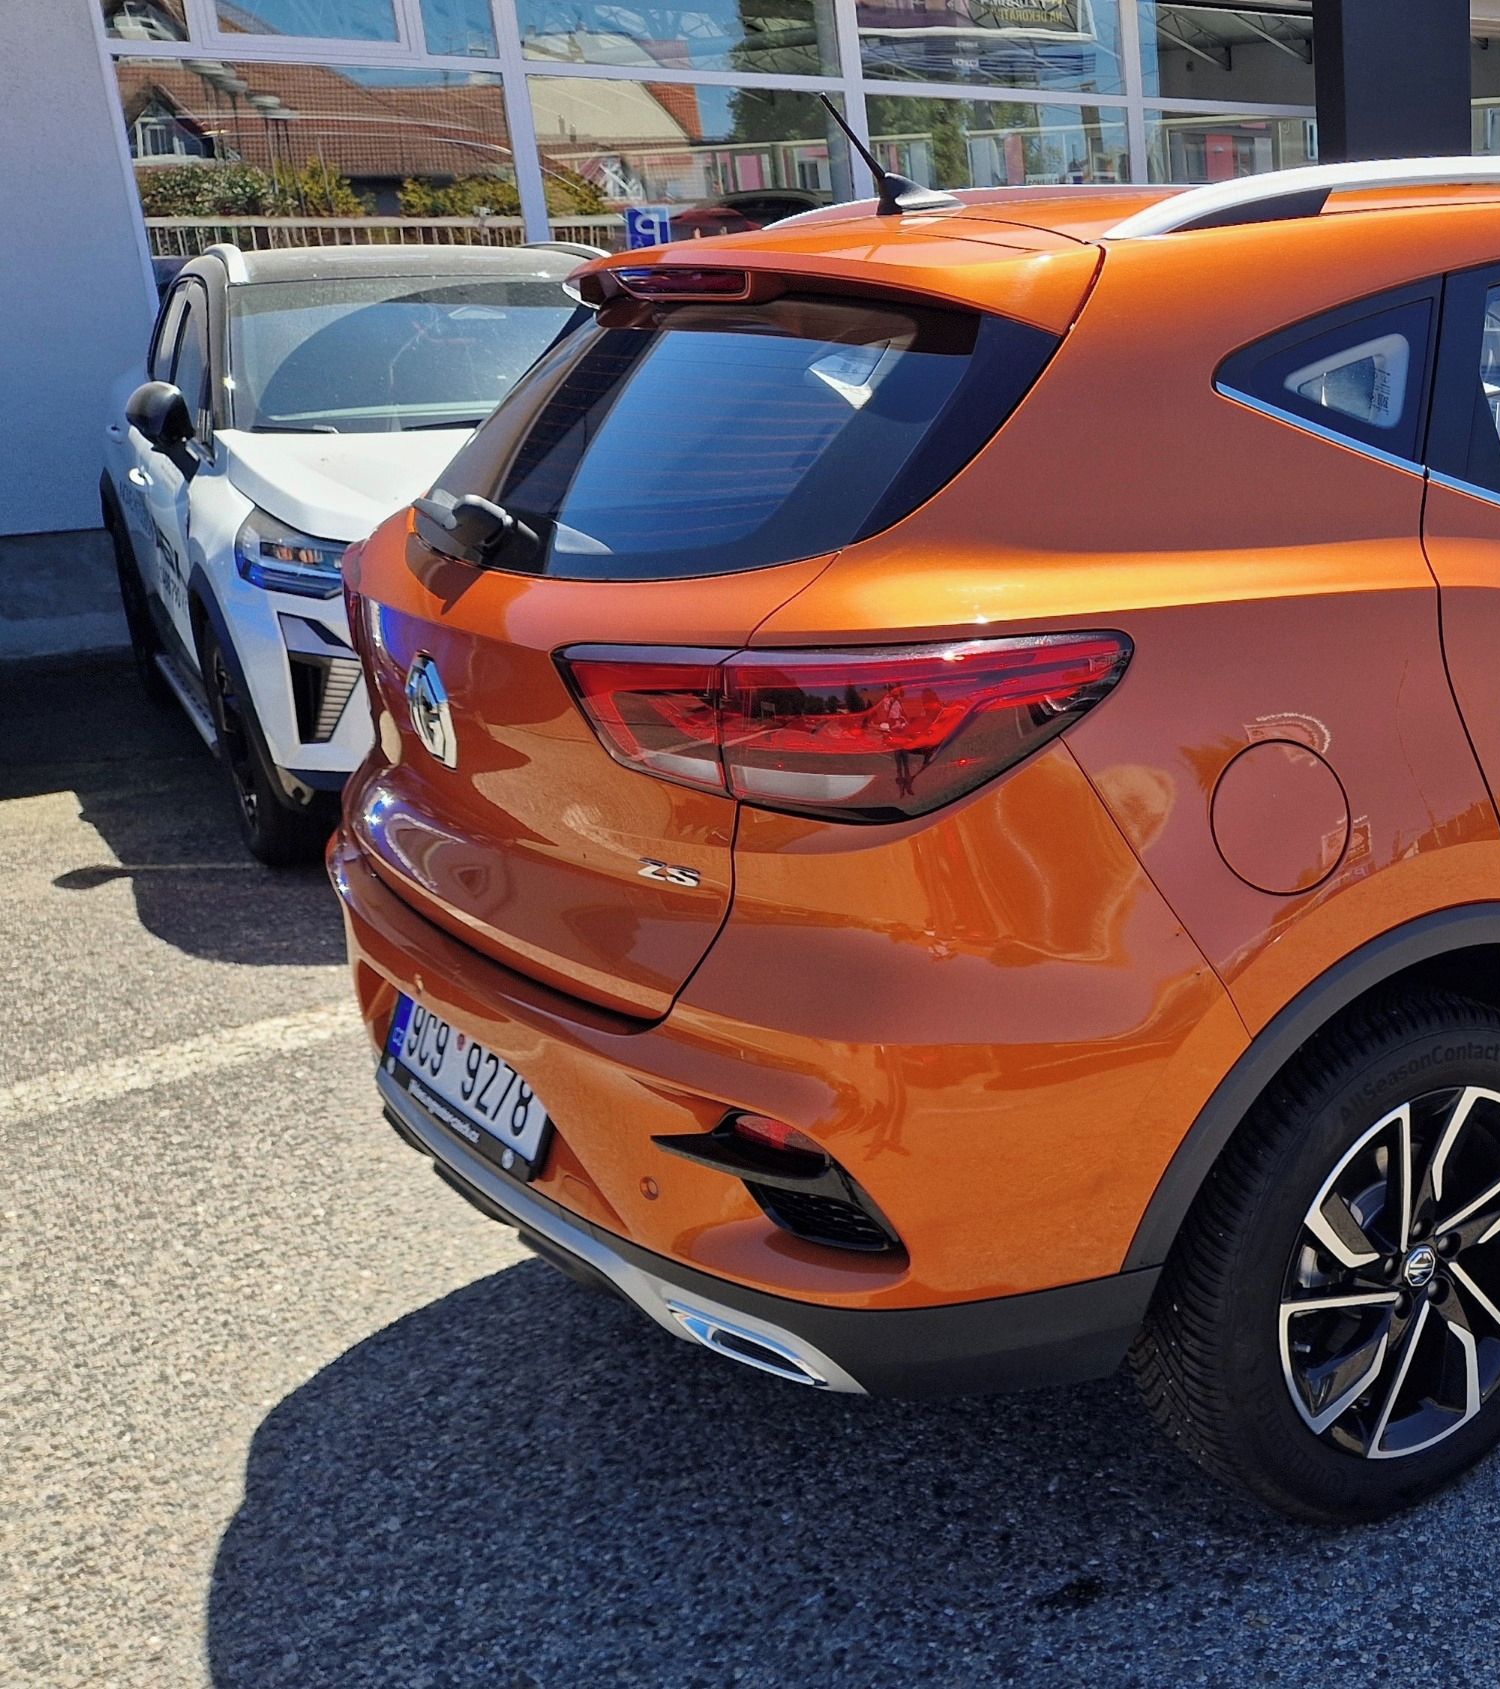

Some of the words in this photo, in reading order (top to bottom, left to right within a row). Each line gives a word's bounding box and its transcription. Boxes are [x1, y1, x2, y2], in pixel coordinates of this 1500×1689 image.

[637, 857, 700, 887] ZS
[407, 1005, 450, 1078] 9C9
[461, 1041, 534, 1138] 9278
